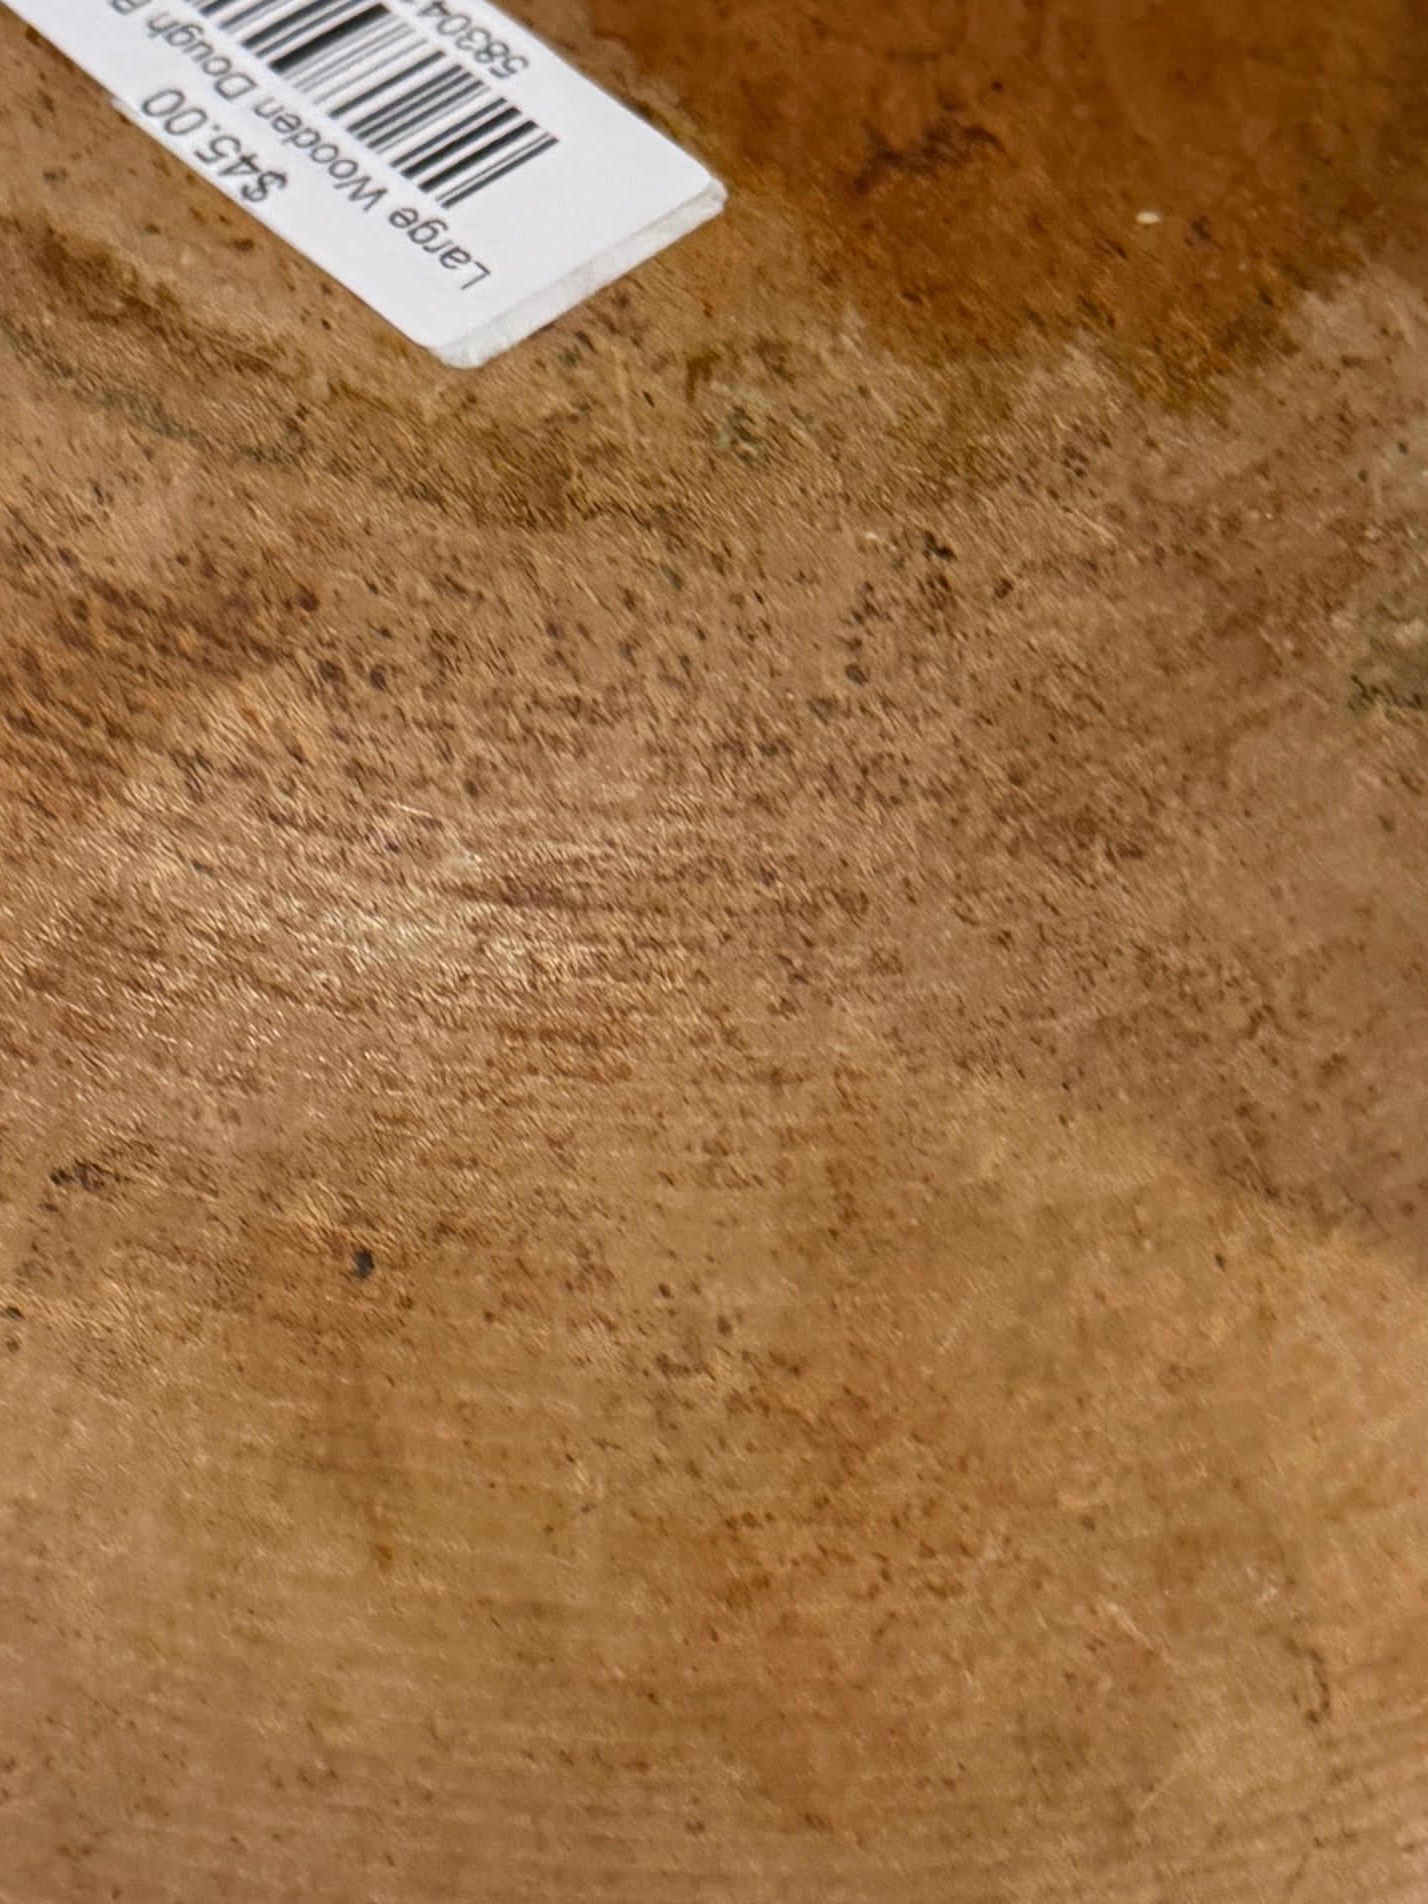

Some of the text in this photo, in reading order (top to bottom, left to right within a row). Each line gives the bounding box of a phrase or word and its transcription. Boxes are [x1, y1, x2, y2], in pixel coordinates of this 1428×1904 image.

[146, 12, 257, 101] Dough
[141, 87, 288, 203] $45.00
[252, 98, 387, 212] Wooden
[388, 207, 491, 290] Large
